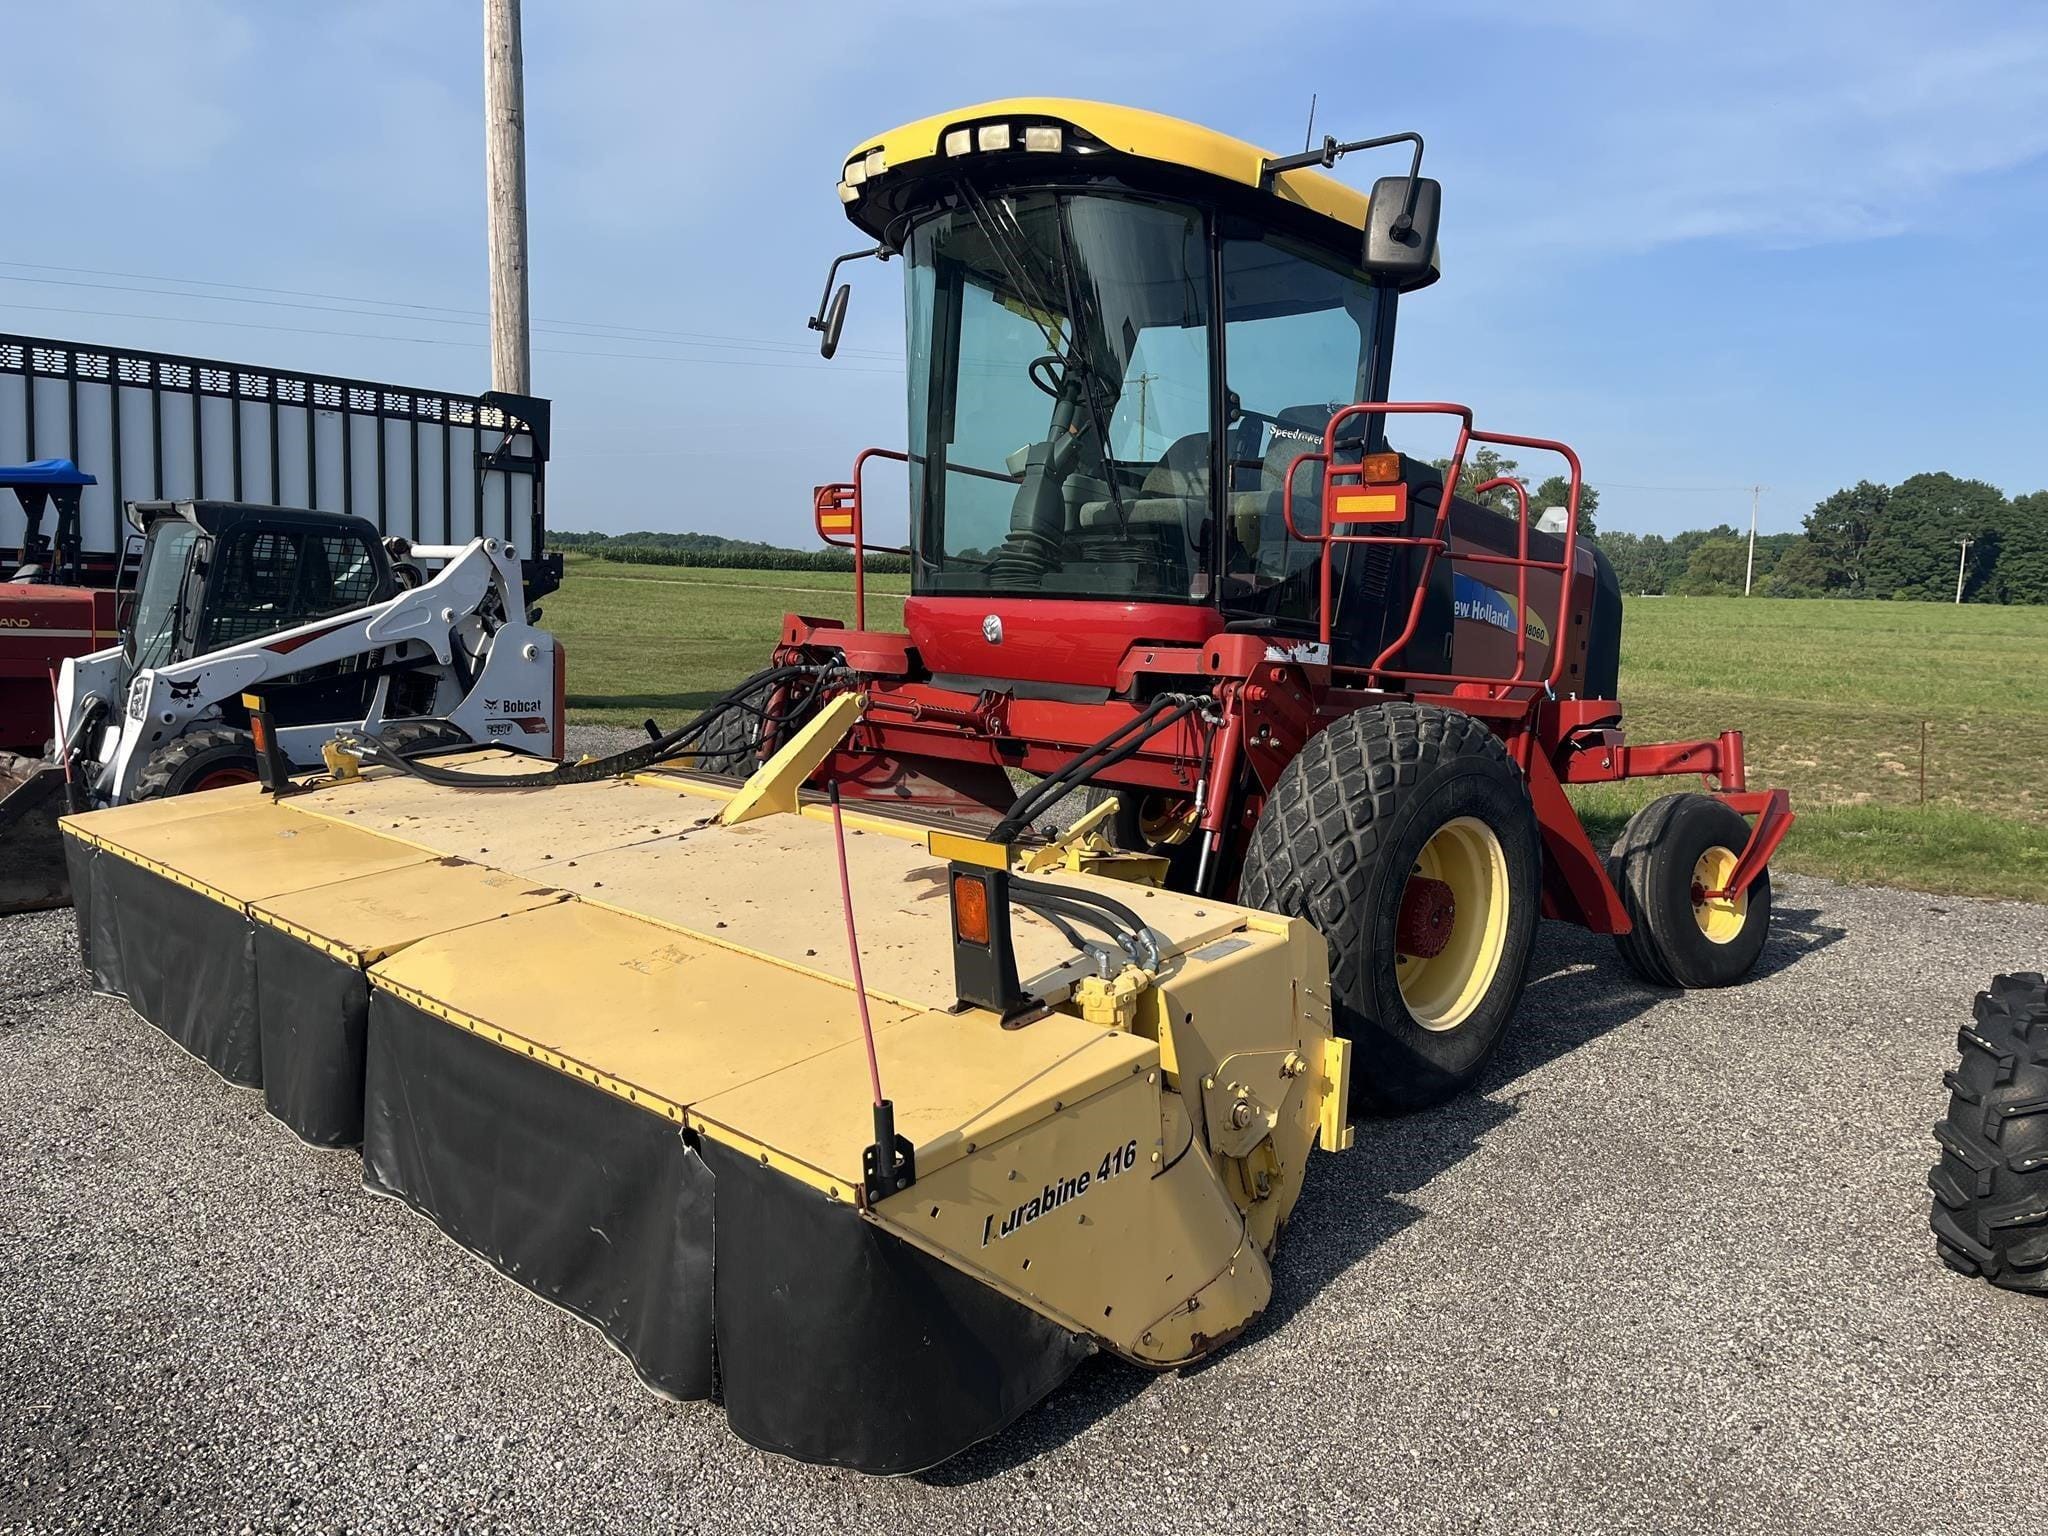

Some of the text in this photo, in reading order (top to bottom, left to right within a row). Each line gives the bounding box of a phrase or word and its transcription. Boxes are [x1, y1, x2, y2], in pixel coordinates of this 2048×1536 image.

[1269, 424, 1324, 445] Speedrower
[1454, 600, 1510, 628] ew Holland
[503, 700, 542, 713] Bobcat
[1095, 1139, 1137, 1184] 416
